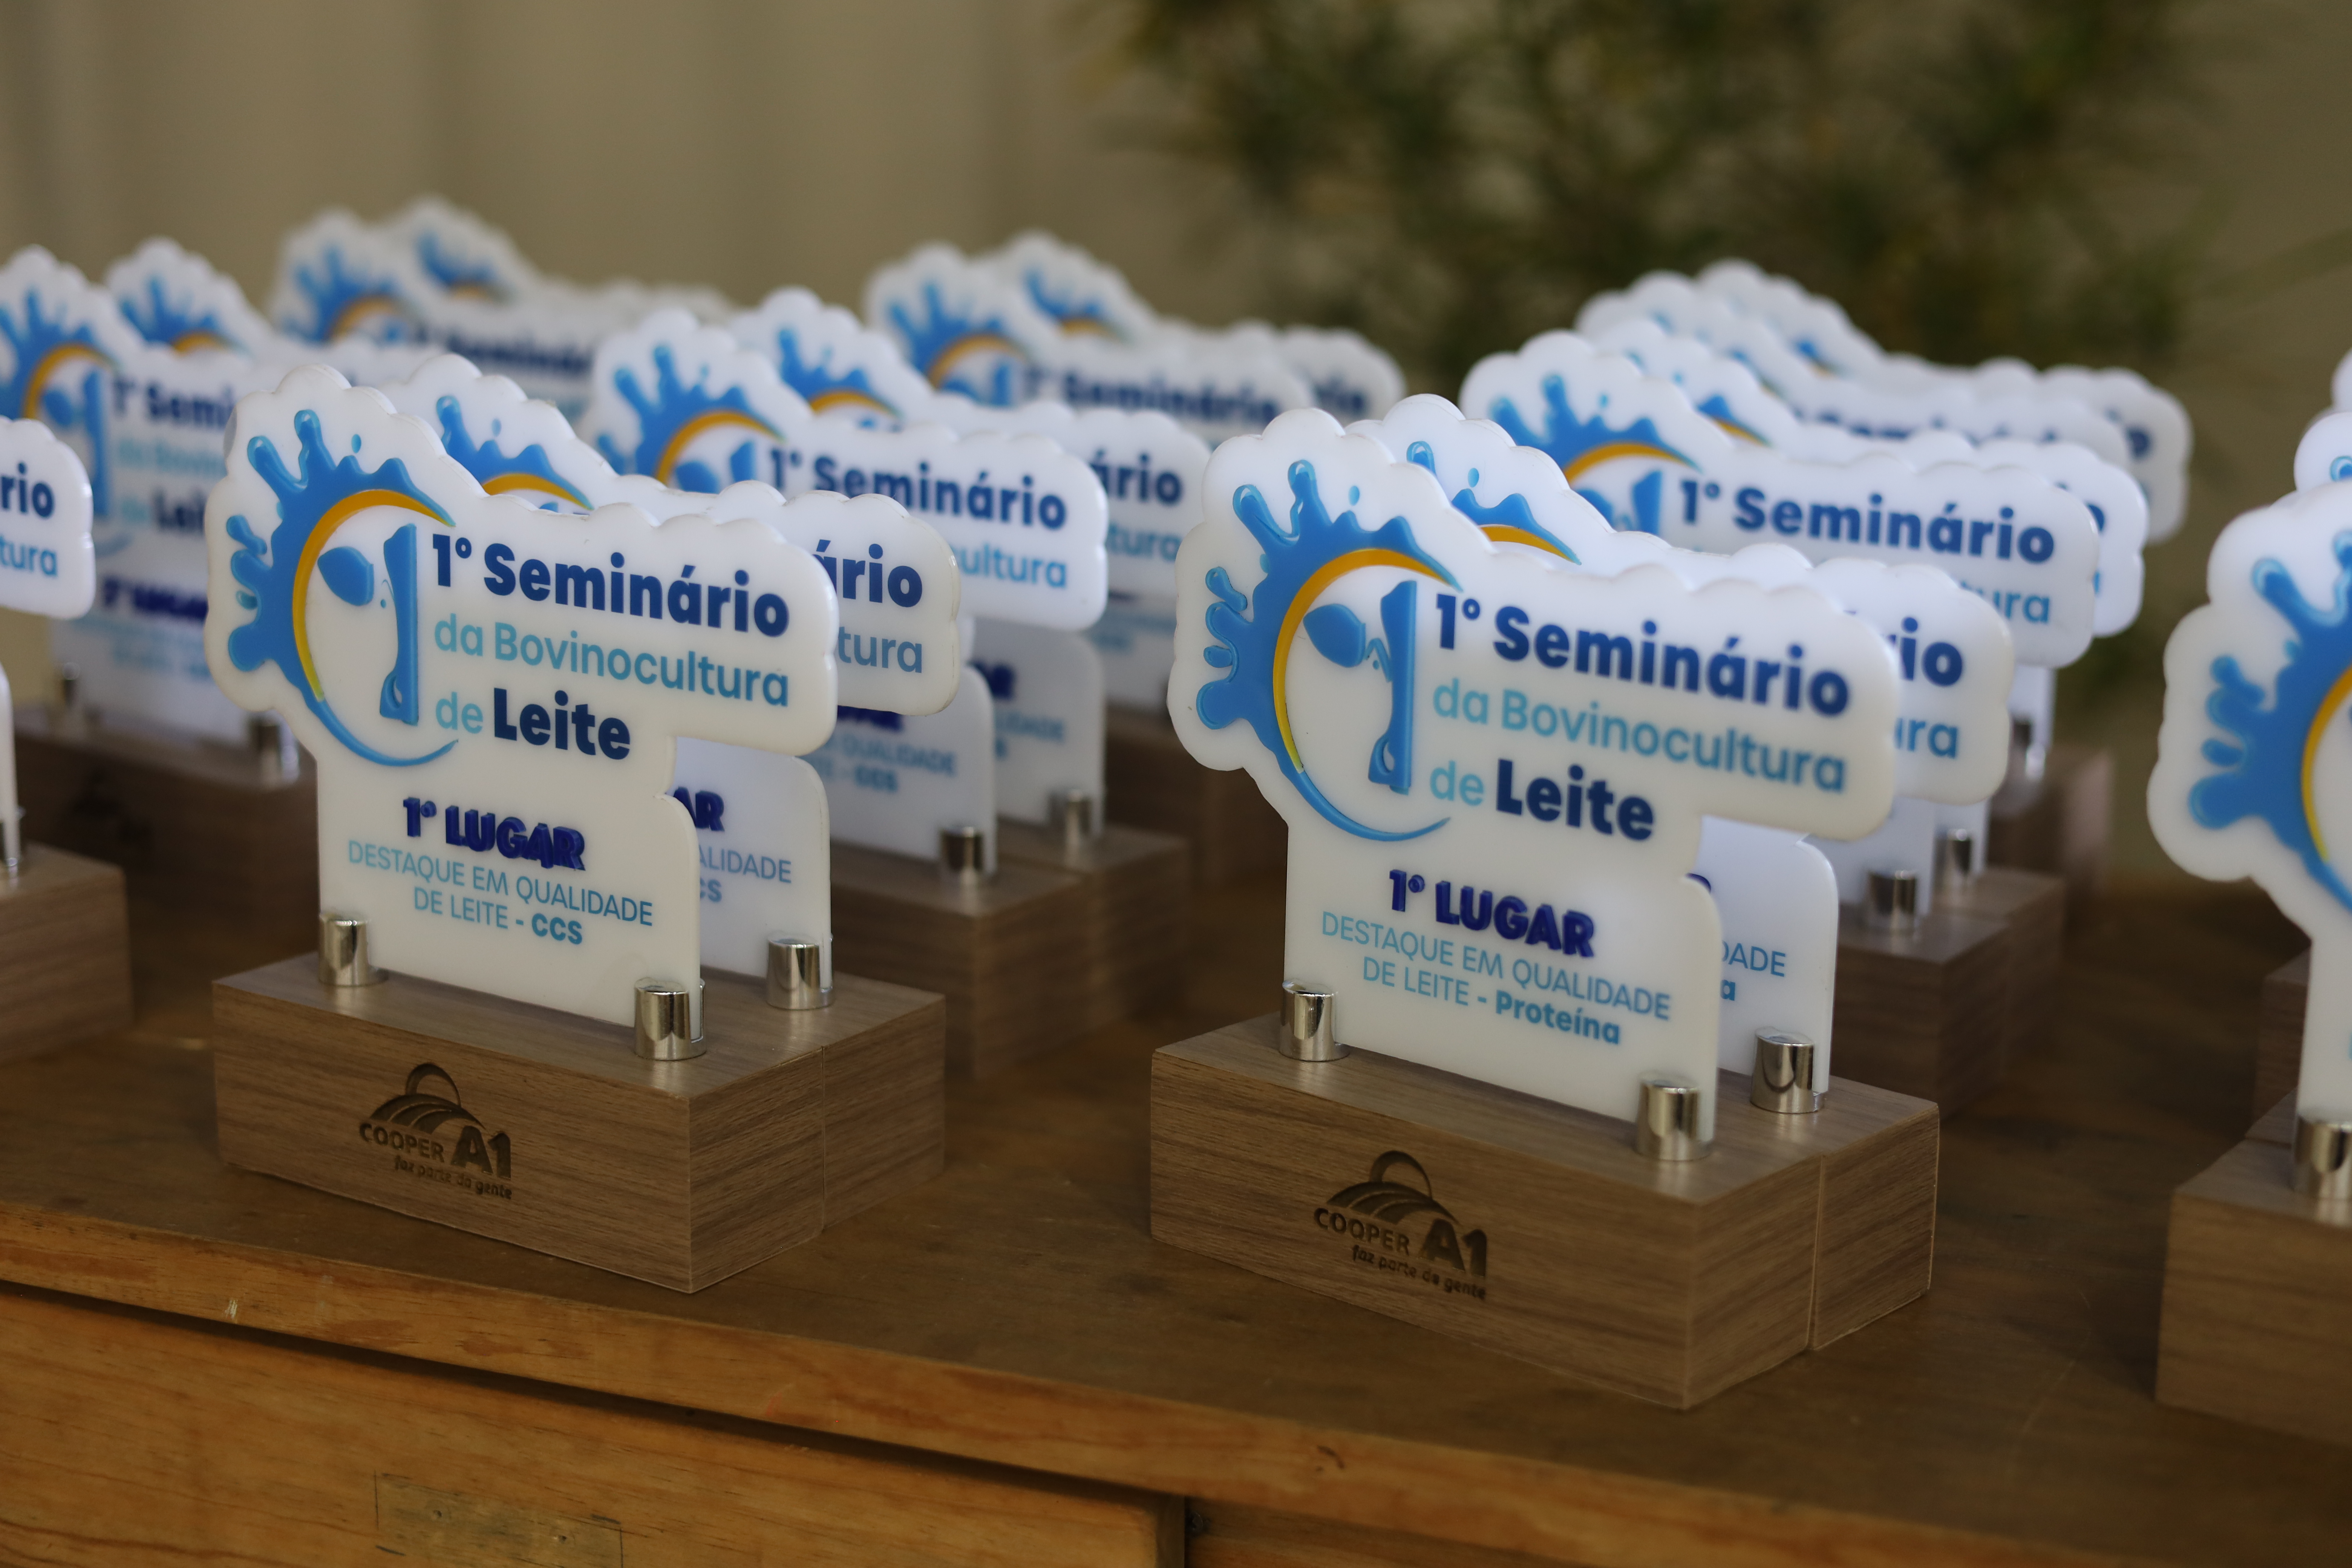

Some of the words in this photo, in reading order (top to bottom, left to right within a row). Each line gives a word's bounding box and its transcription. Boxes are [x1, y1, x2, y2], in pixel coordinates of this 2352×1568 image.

[814, 456, 1066, 530] Seminário
[1734, 486, 2054, 565] Seminário
[484, 543, 789, 637] Seminário
[434, 613, 483, 657] da
[495, 621, 789, 708] Bovinocultura
[1493, 604, 1850, 718] Seminário
[435, 692, 483, 735] de
[494, 687, 631, 760] Leite
[1432, 678, 1488, 726] da
[1501, 689, 1845, 794] Bovinocultura
[446, 805, 586, 871] LUGAR
[1430, 761, 1485, 807] de
[1496, 758, 1653, 842] Leite
[349, 840, 465, 887] DESTAQUE
[473, 866, 508, 896] EM
[517, 875, 653, 926] QUALIDADE
[414, 887, 443, 915] DE
[451, 898, 508, 929] LEITE
[531, 913, 583, 945] CCS
[1435, 880, 1594, 958] LUGAR
[1322, 911, 1454, 966] DESTAQUE
[1462, 946, 1502, 979] EM
[1512, 958, 1671, 1021] QUALIDADE
[1363, 956, 1395, 988] DE
[1404, 964, 1468, 1006] LEITE
[1495, 989, 1620, 1045] Proteína
[360, 1123, 444, 1162] COOPER
[451, 1125, 511, 1180] A1
[1314, 1208, 1409, 1256] COOPER
[1418, 1219, 1487, 1279] A1
